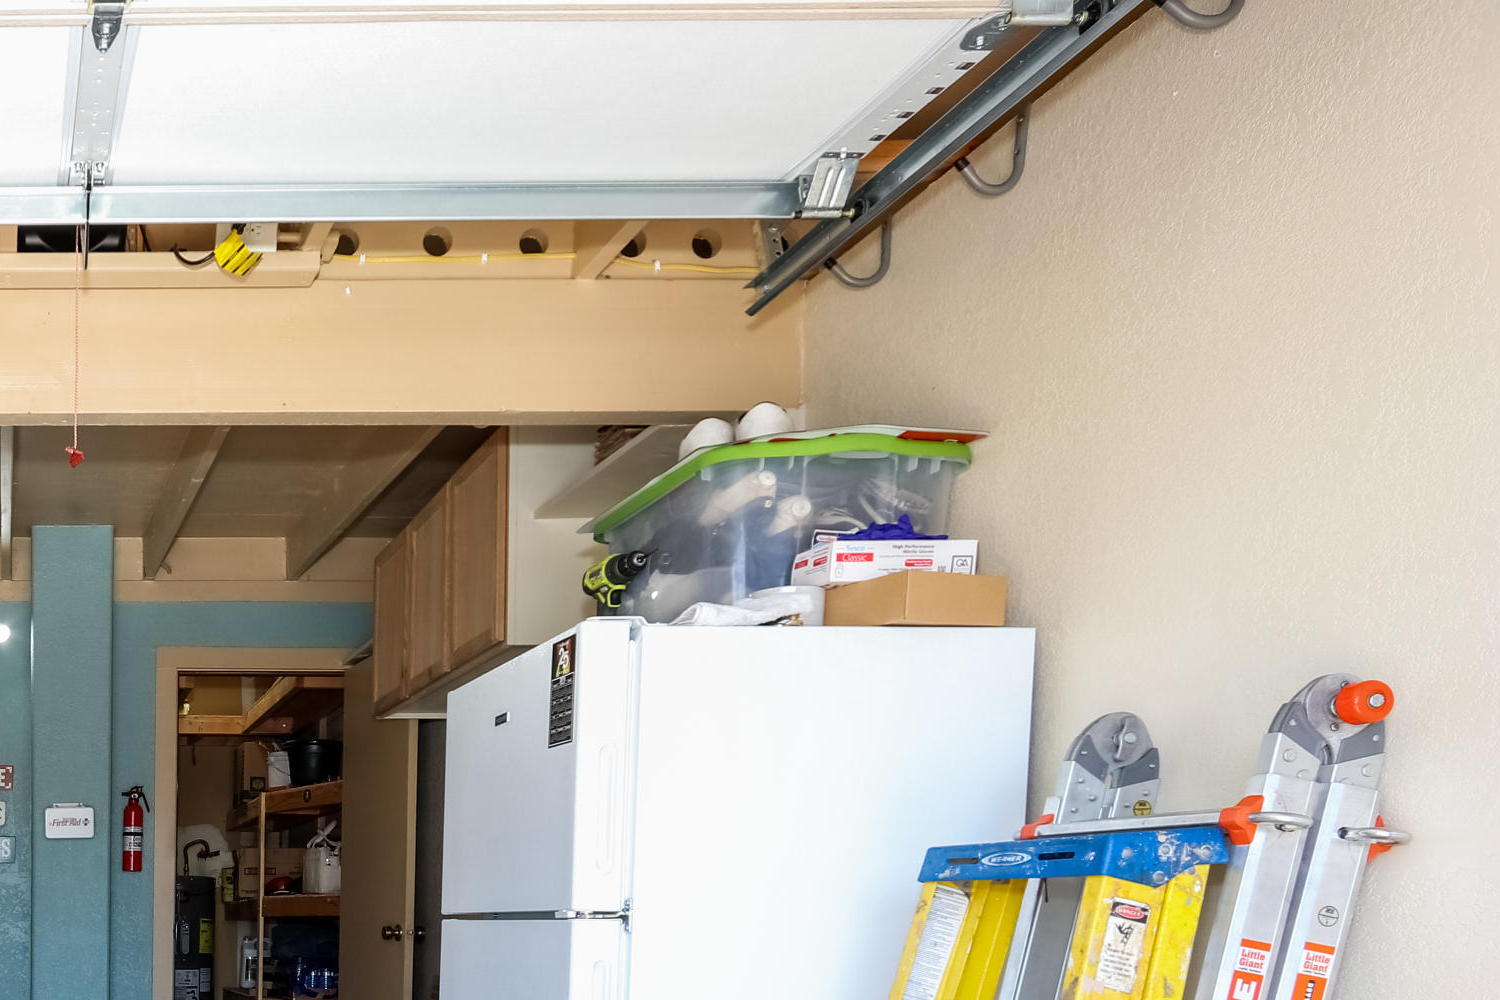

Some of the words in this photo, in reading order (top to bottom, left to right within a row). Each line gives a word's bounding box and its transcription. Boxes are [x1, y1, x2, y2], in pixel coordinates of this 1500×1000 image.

[842, 553, 868, 562] Classic
[69, 817, 82, 827] Aid
[1241, 948, 1266, 961] Little
[1305, 951, 1331, 964] Little
[1239, 957, 1264, 970] Giant
[1303, 960, 1329, 973] Giant
